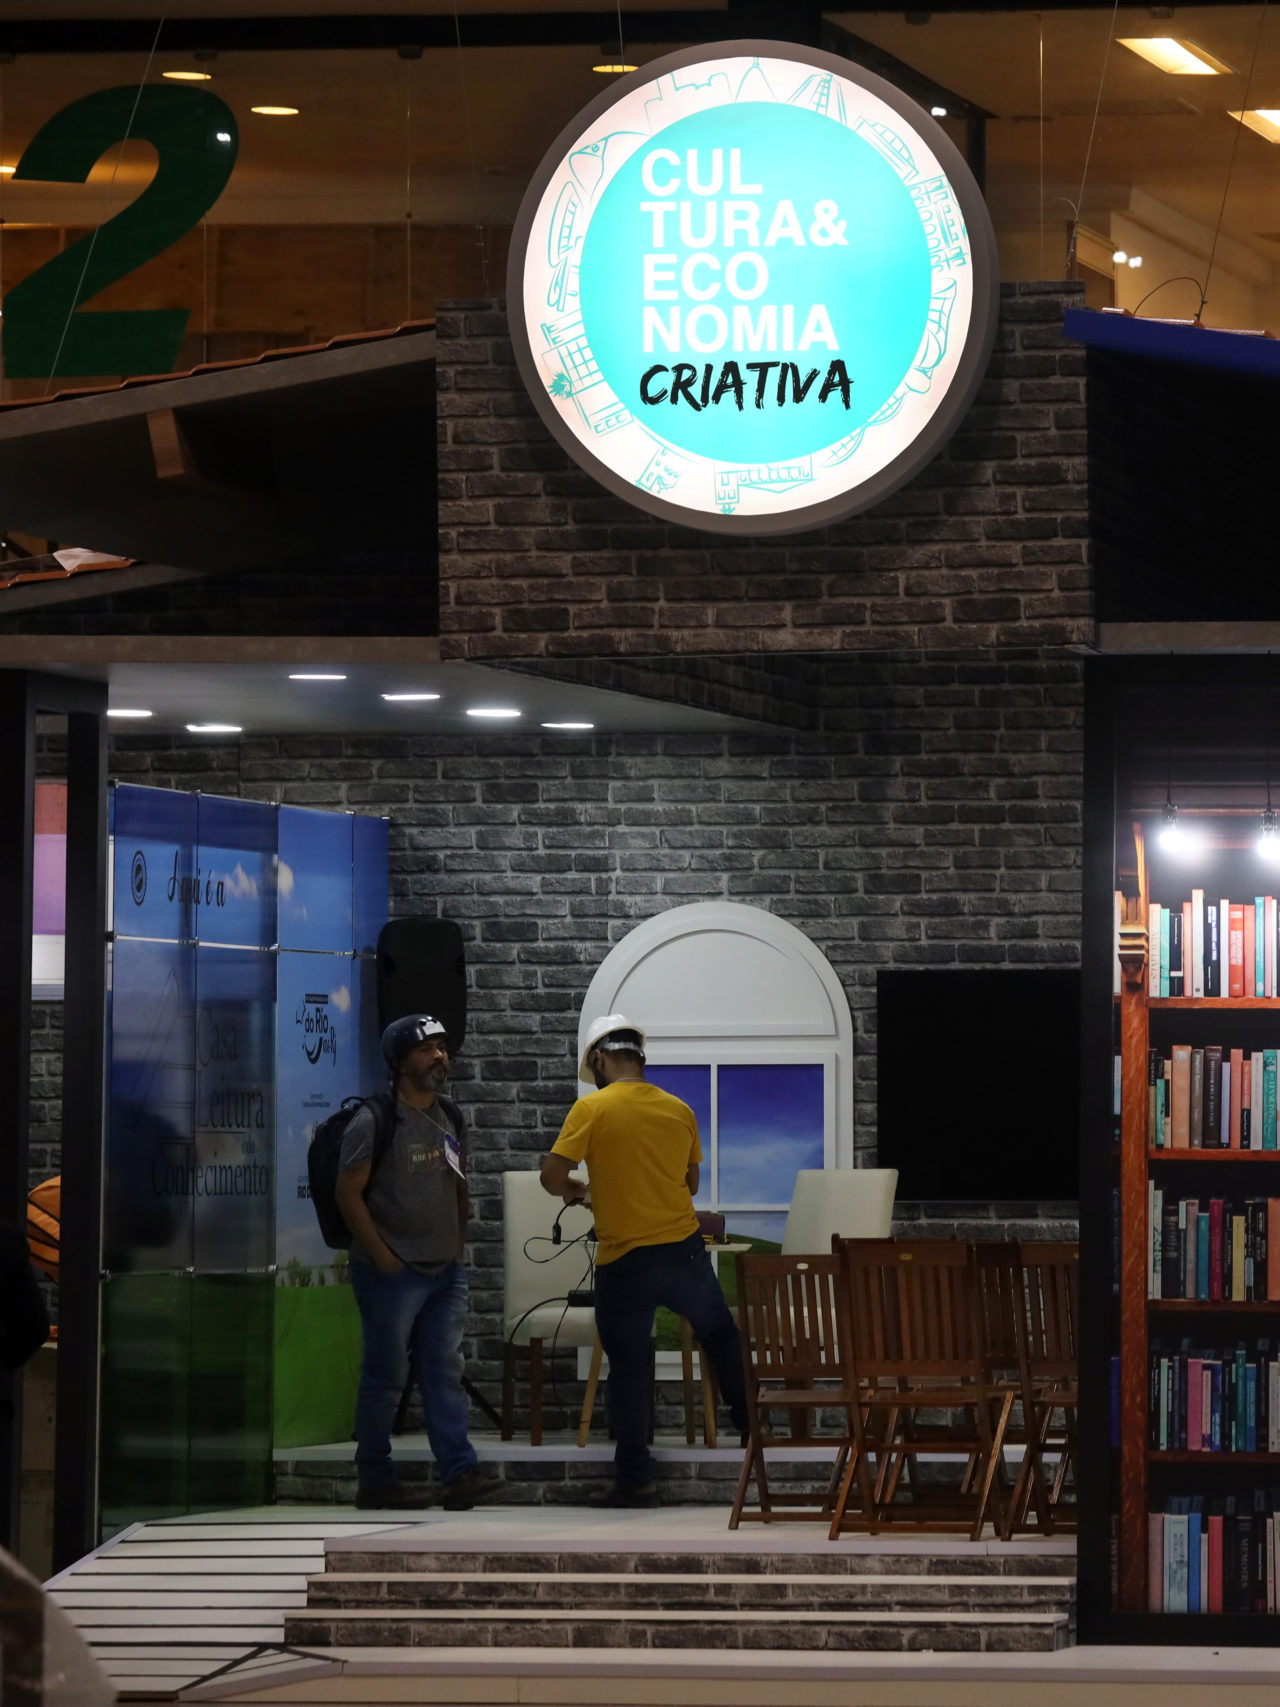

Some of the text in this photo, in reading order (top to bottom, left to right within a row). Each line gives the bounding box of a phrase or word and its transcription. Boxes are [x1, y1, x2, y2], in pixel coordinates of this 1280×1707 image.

[640, 147, 763, 197] CUL
[3, 83, 240, 379] 2
[639, 198, 850, 248] TURA&
[642, 251, 770, 301] ECO
[642, 303, 841, 353] NOMIA
[638, 358, 856, 412] CRIATIVA
[315, 1006, 329, 1034] Rio
[150, 1143, 270, 1197] Conhecimento
[1240, 1536, 1249, 1589] MEMOIRS
